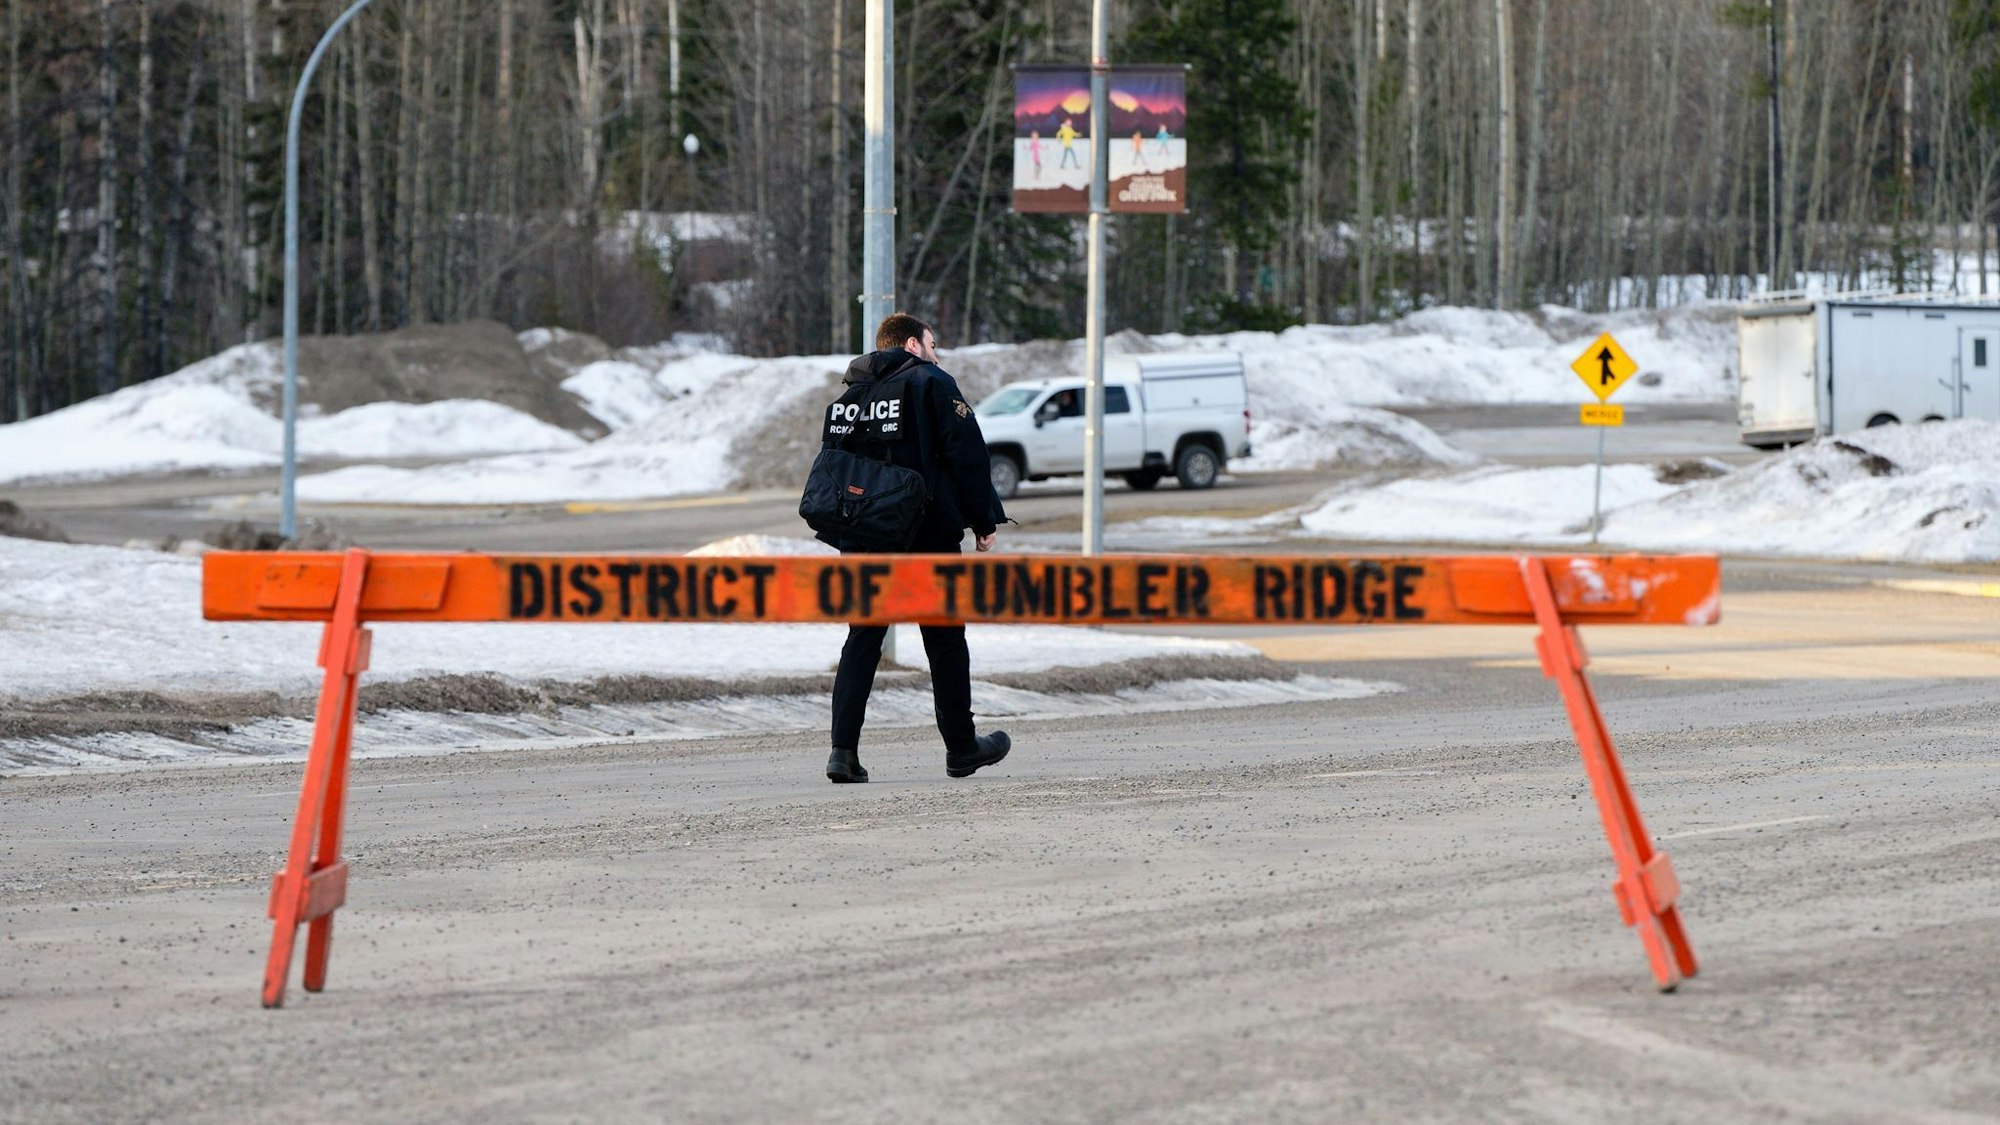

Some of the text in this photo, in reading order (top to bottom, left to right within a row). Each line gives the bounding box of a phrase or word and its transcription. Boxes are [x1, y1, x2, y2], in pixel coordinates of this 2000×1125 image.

[831, 399, 900, 421] POLICE
[882, 423, 898, 432] GRC
[509, 563, 1424, 619] DISTRICT OF TUMBLER RIDGE
